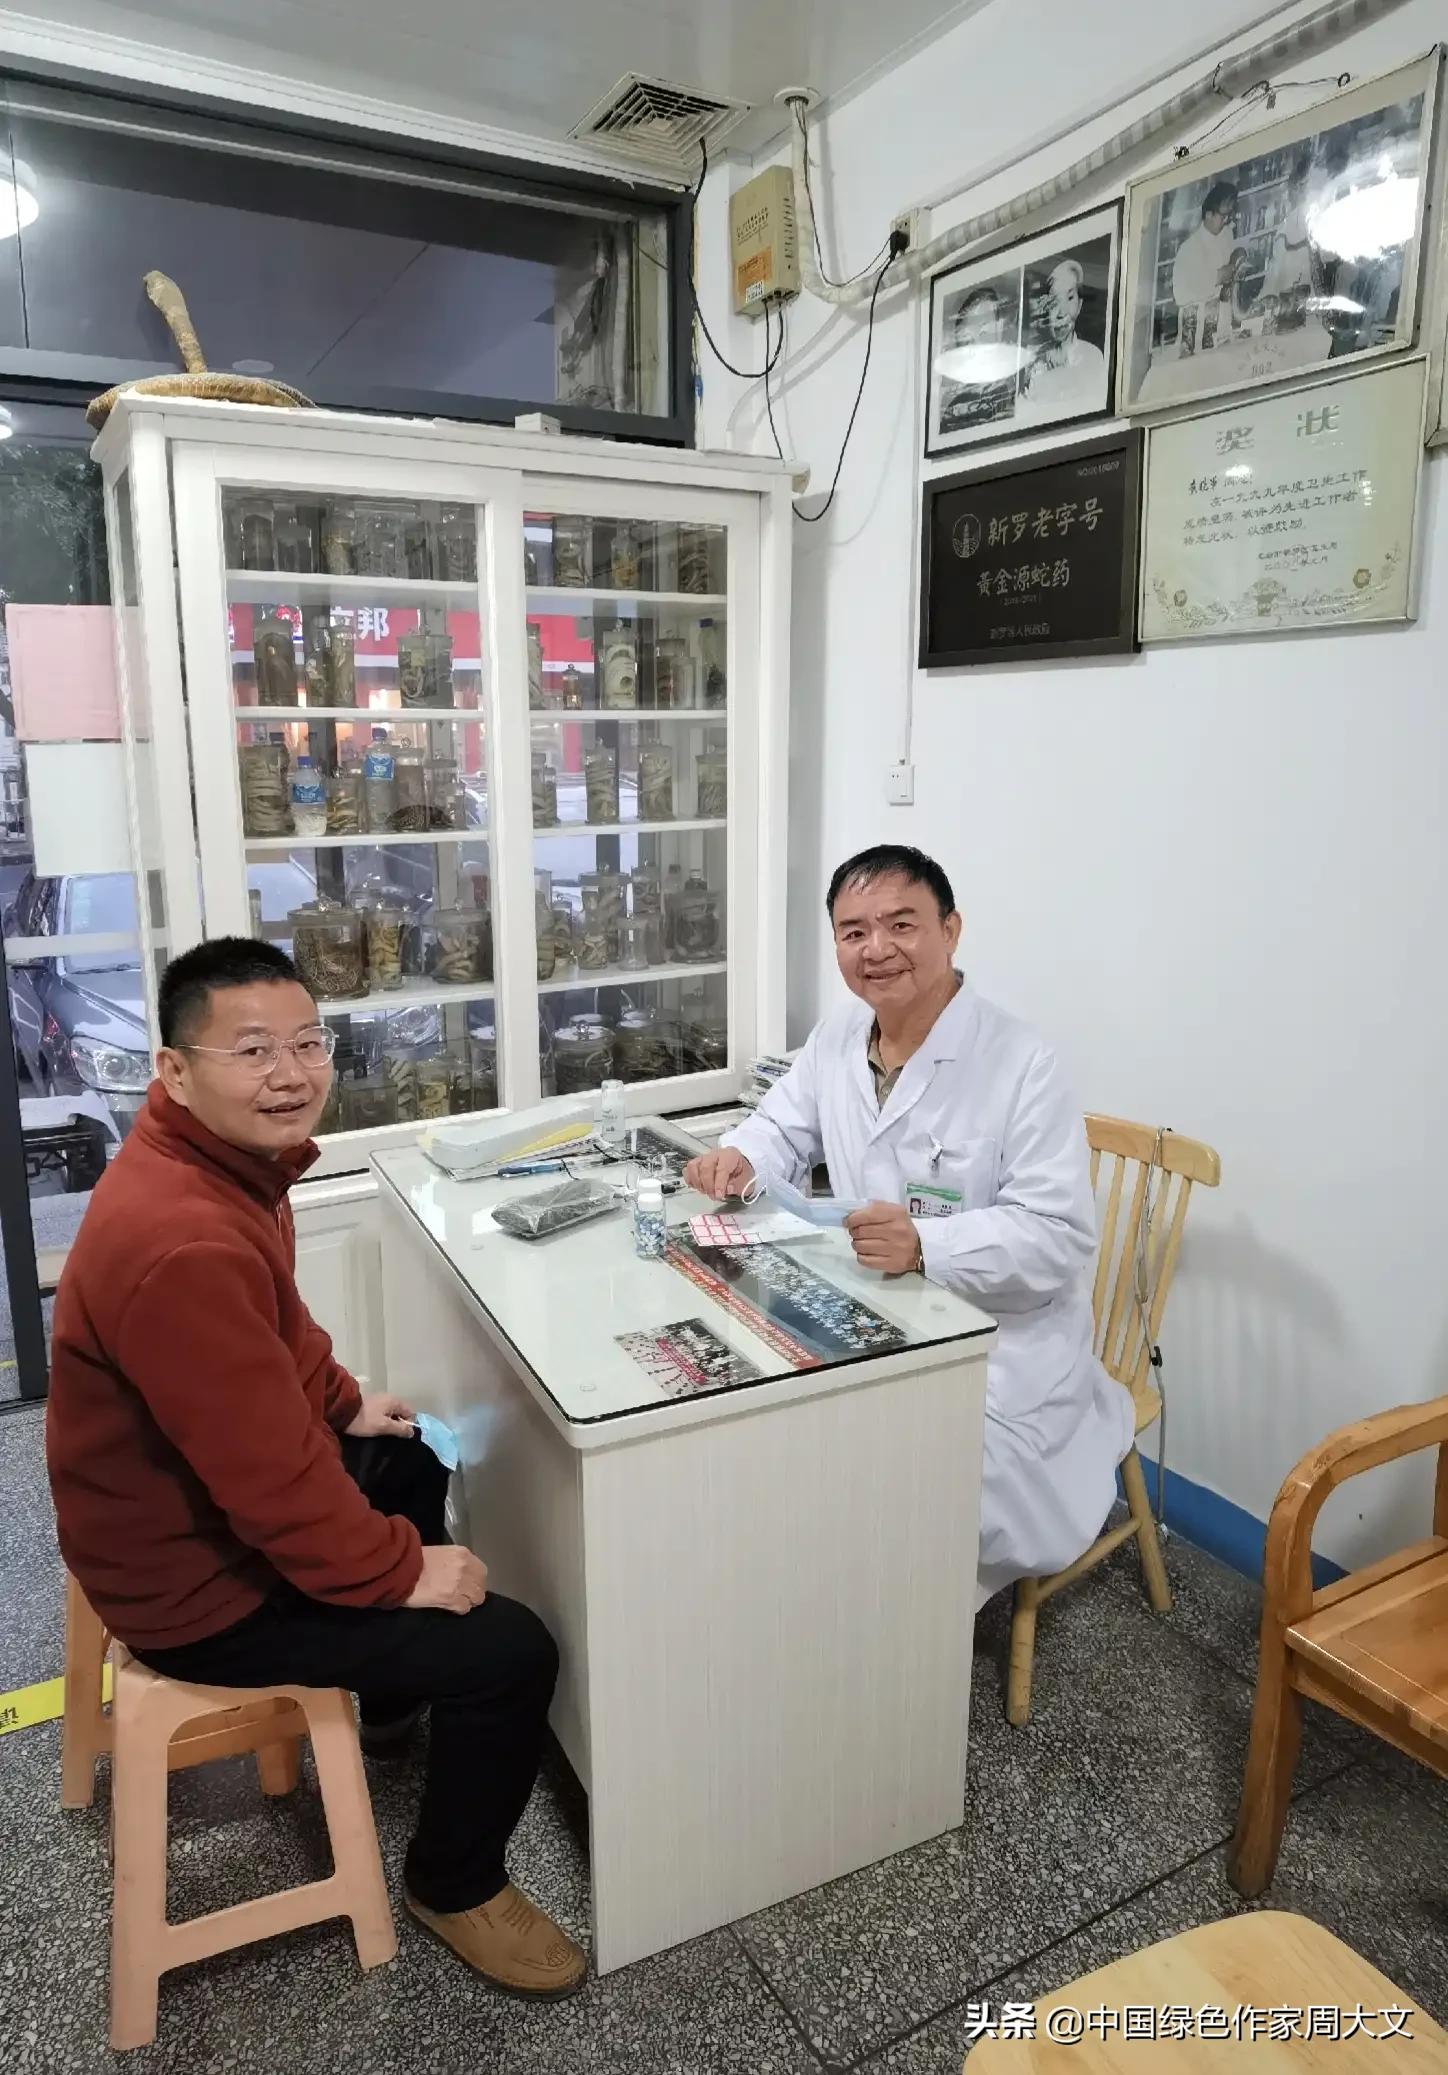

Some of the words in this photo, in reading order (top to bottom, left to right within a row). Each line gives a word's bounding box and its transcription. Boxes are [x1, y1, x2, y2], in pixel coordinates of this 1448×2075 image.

[988, 497, 1103, 547] 新罗老字号
